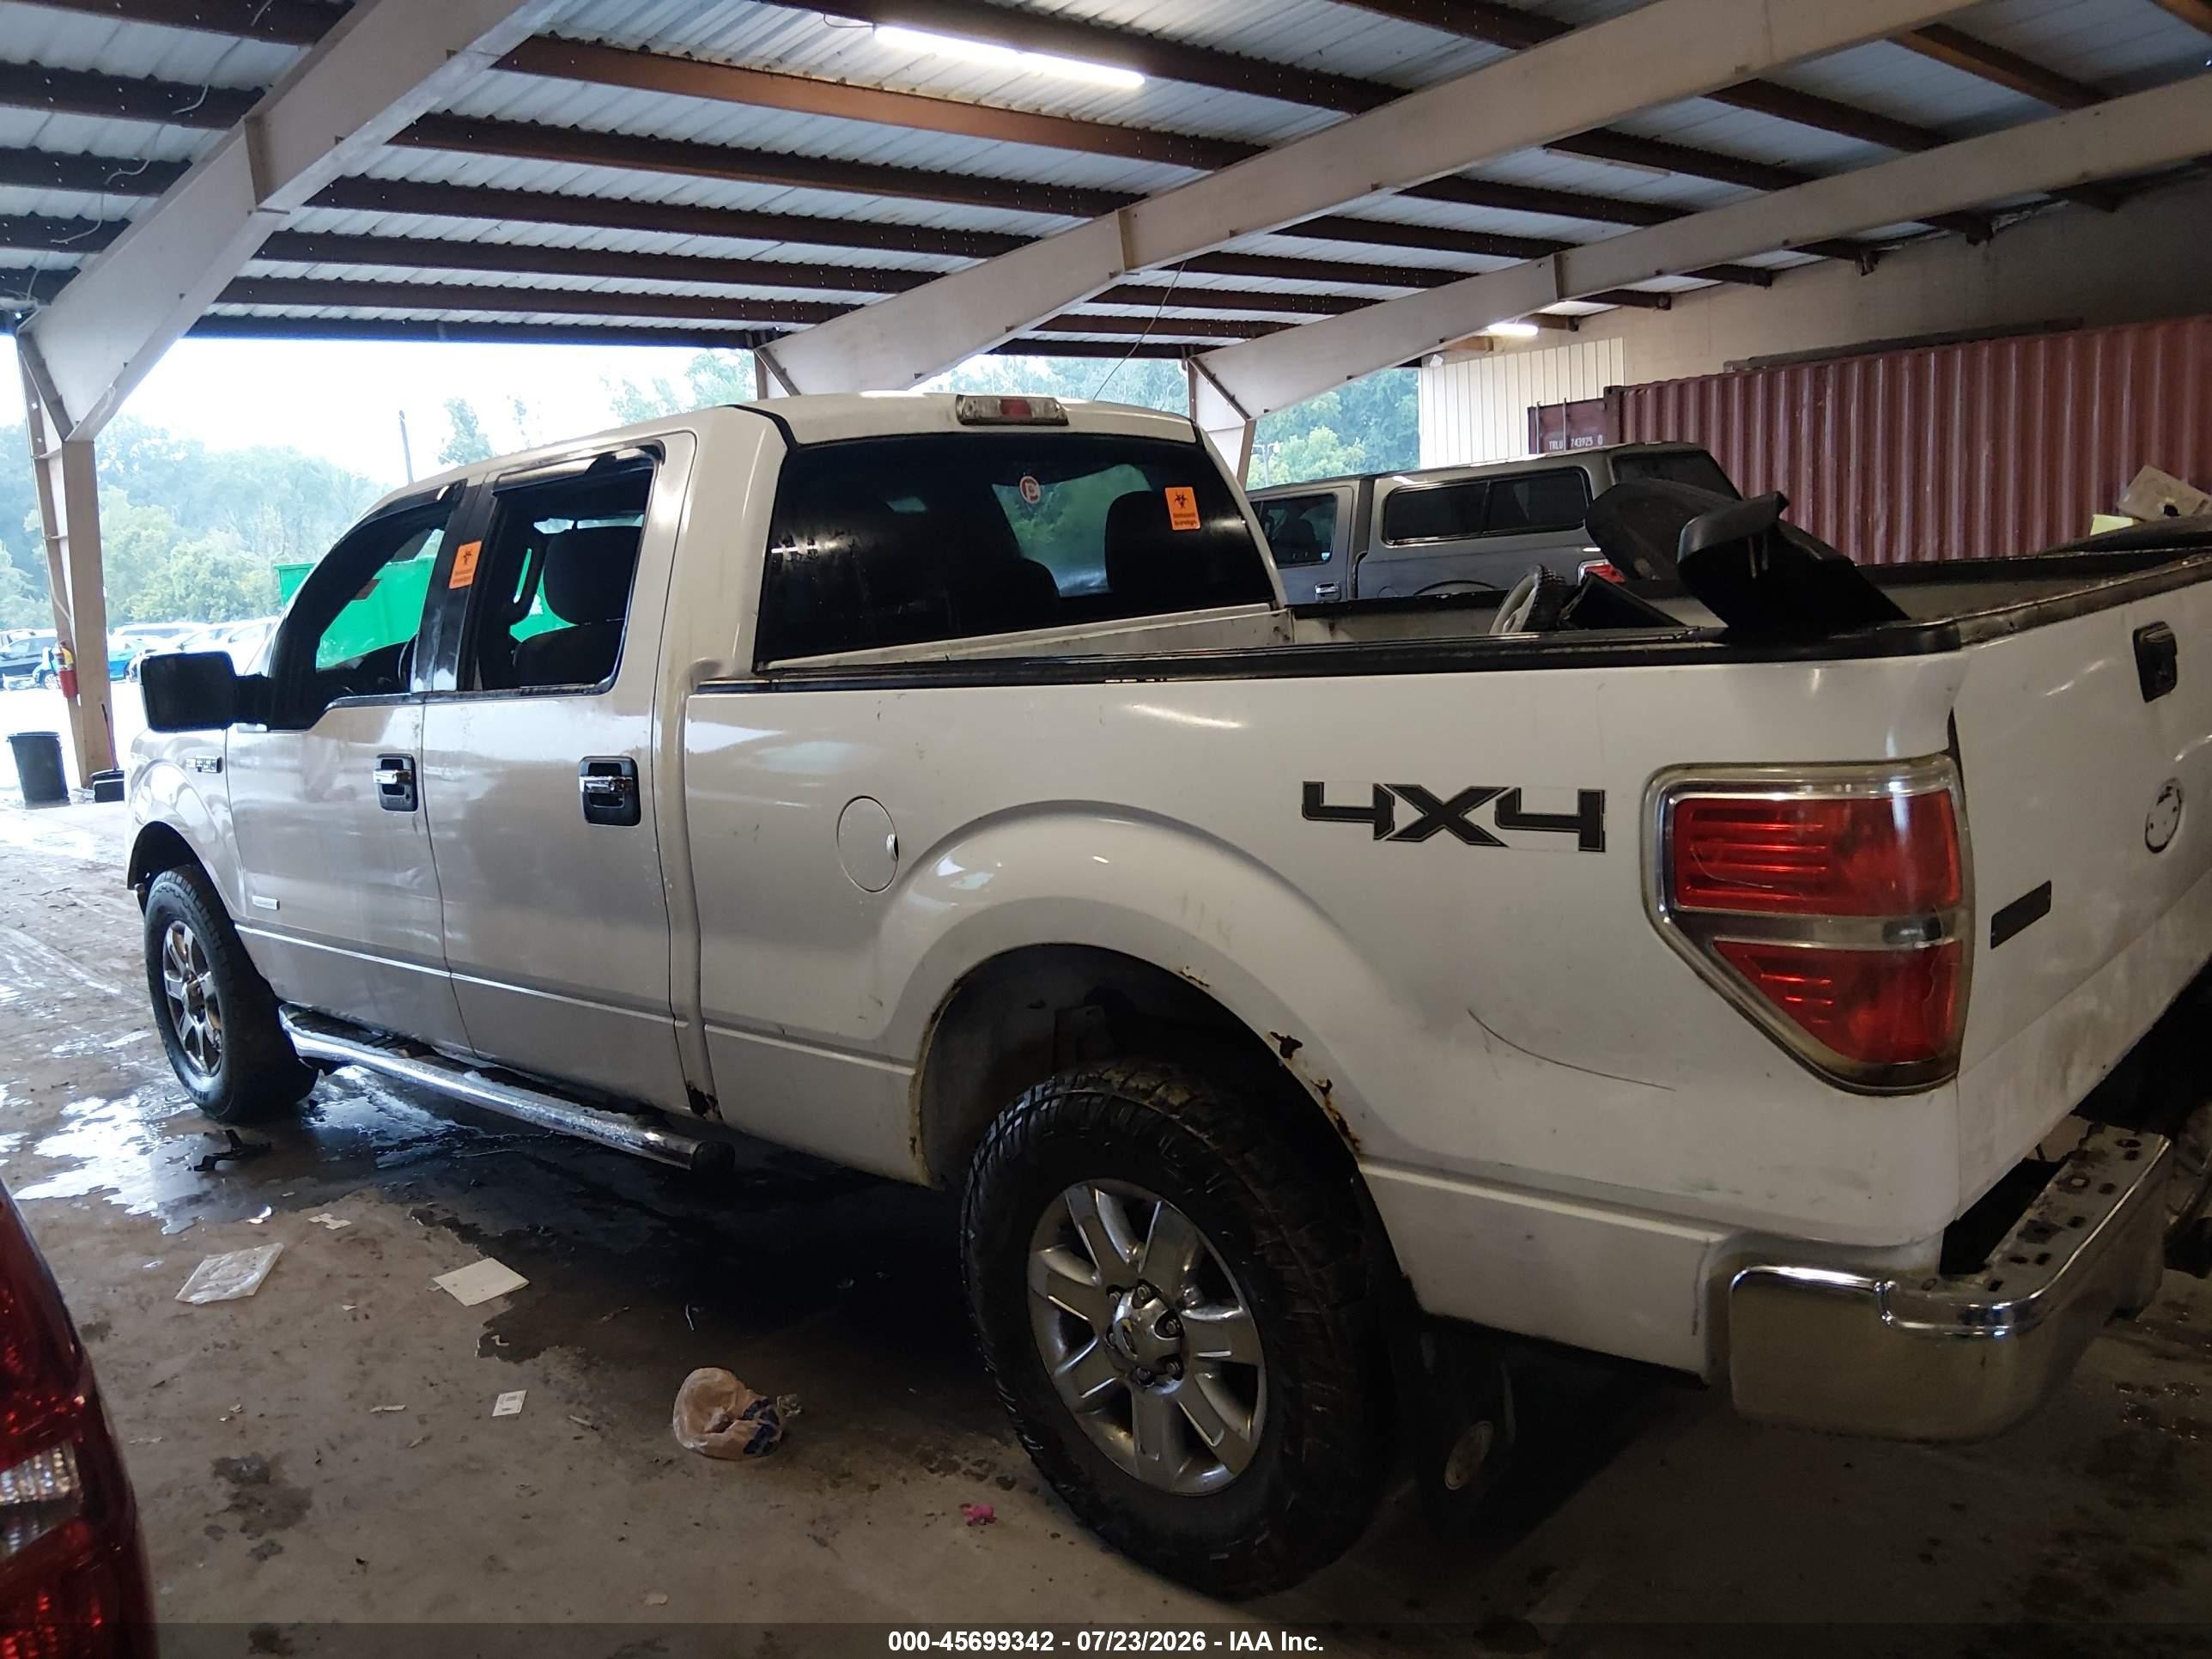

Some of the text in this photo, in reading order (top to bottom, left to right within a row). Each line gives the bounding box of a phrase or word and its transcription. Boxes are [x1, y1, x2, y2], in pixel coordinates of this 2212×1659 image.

[1549, 434, 1603, 451] TRLU 743925 0
